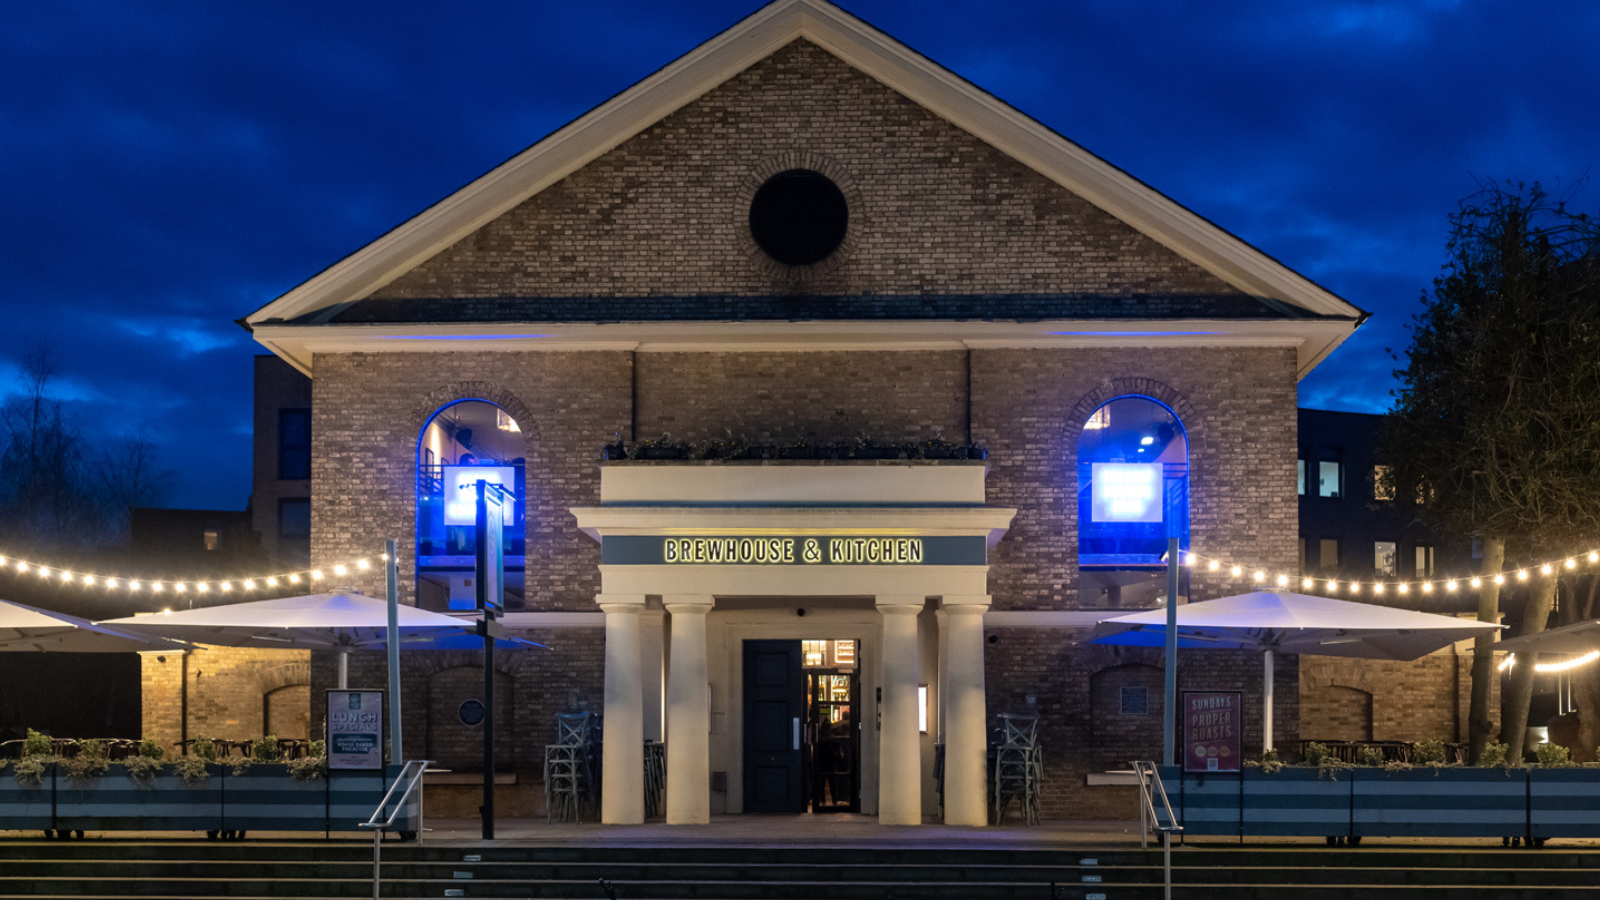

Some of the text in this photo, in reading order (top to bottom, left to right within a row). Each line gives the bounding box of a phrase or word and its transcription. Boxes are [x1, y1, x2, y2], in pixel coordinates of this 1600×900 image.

[665, 539, 922, 561] BREWHOUSE & KITCHEN
[1192, 696, 1231, 711] SUNDAYS
[332, 713, 378, 723] LUNCH
[1192, 712, 1231, 727] PROPER
[332, 723, 378, 731] SPECIALS
[1192, 725, 1231, 741] ROASTS
